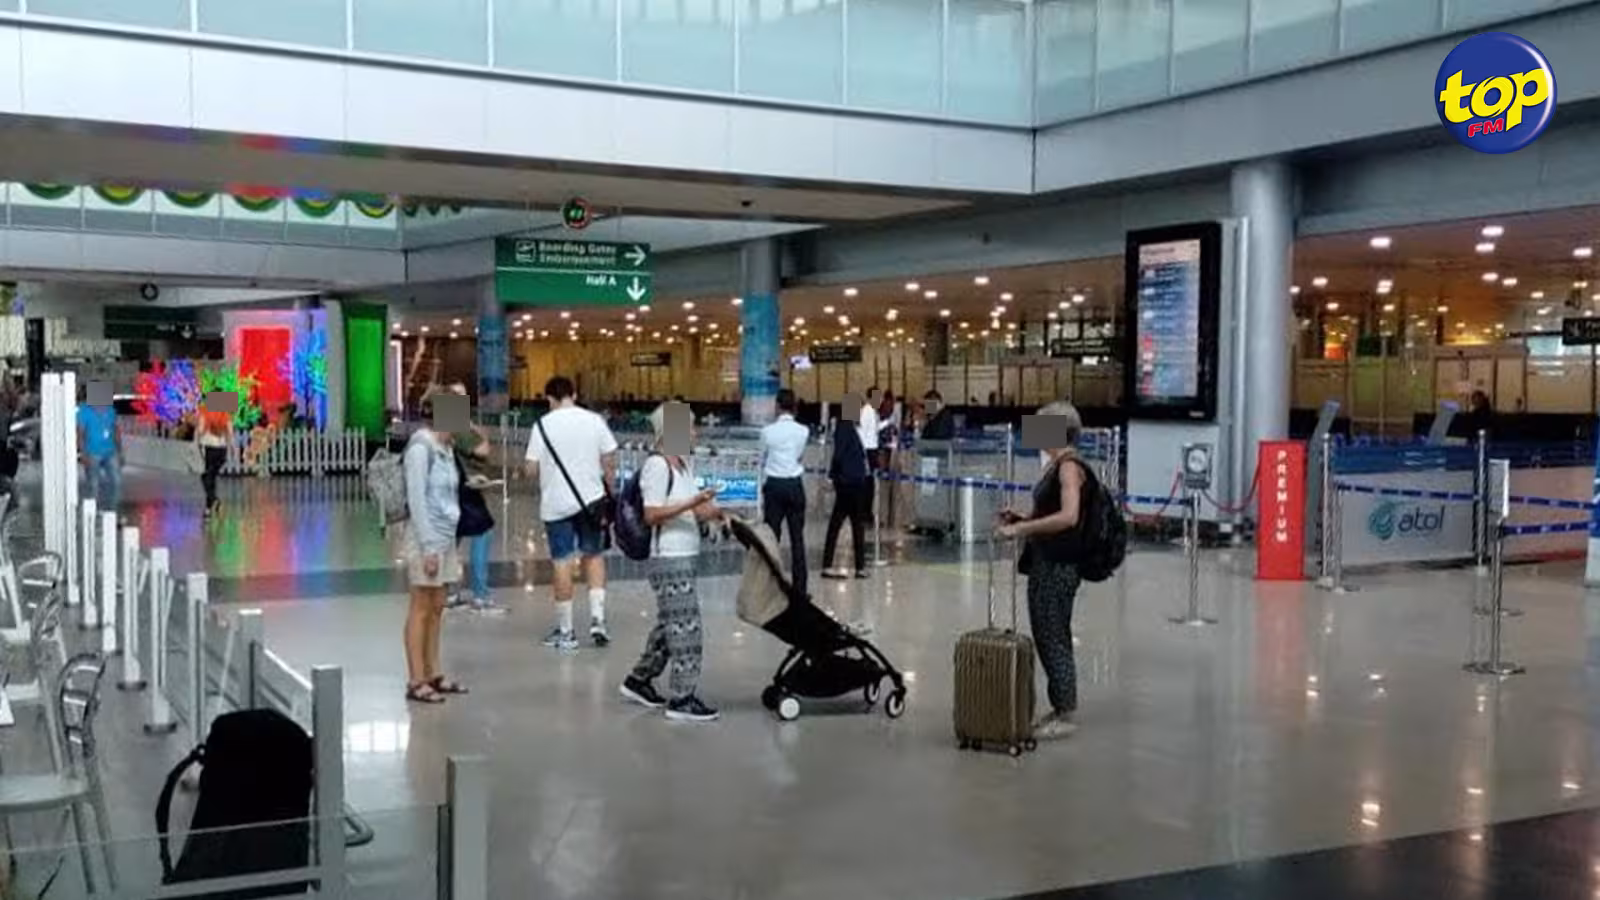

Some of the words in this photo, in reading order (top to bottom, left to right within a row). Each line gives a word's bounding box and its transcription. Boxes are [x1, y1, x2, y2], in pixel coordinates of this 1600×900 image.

[539, 241, 586, 255] Boarding
[586, 275, 607, 286] Hall
[608, 276, 617, 286] A
[1276, 450, 1288, 542] PREMIUM
[1398, 505, 1446, 532] atol
